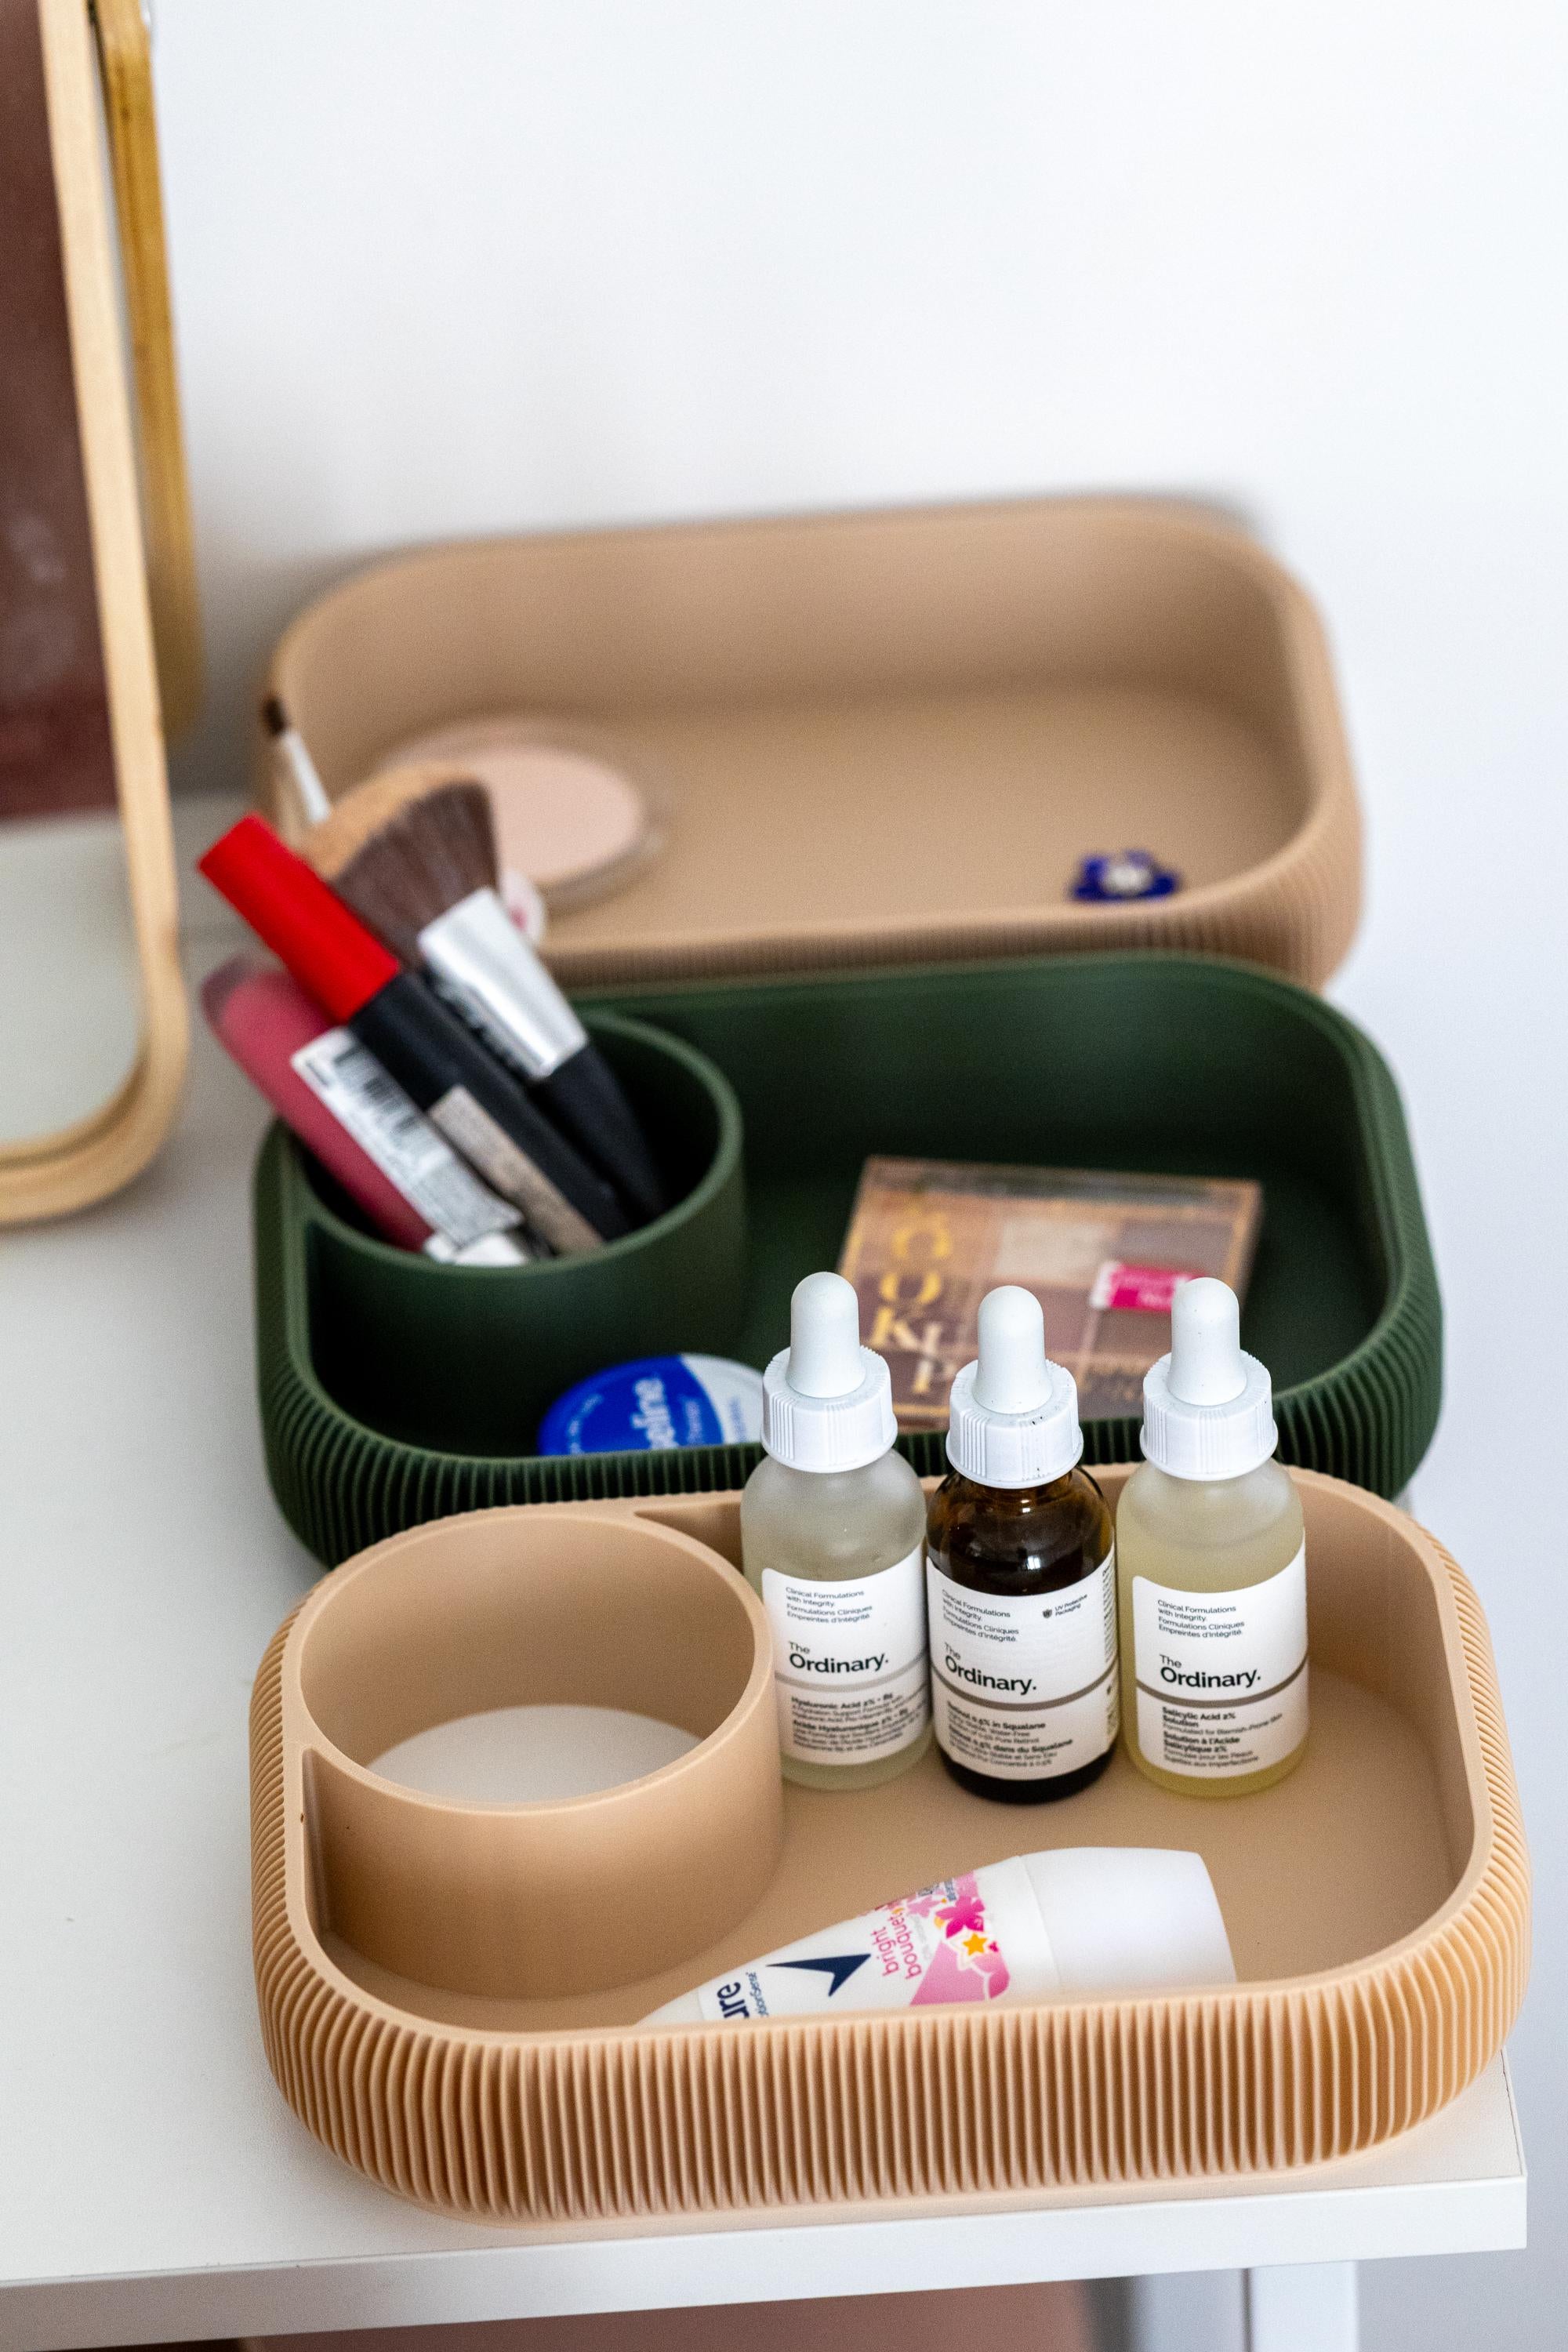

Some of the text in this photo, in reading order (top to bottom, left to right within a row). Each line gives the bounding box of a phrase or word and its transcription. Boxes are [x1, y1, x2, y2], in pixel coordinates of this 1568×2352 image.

[786, 1587, 811, 1598] Clinical
[786, 1603, 873, 1616] Formulations Cliniques
[963, 1602, 1011, 1617] Formulations
[1158, 1599, 1236, 1614] Clinical Formulations
[1158, 1608, 1174, 1617] with
[787, 1611, 829, 1623] Empreintes
[943, 1605, 1019, 1635] Formulations Cliniques
[1159, 1616, 1245, 1631] Formulations Cliniques
[1159, 1624, 1200, 1638] Empreintes
[789, 1641, 811, 1654] The
[945, 1642, 960, 1660] The
[789, 1653, 889, 1674] Ordinary.
[1160, 1653, 1182, 1668] The
[946, 1656, 1037, 1696] Ordinary.
[1160, 1666, 1261, 1688] Ordinary.
[1162, 1706, 1198, 1720] Salicylic
[1002, 1722, 1046, 1731] Squalane
[1163, 1715, 1199, 1727] Solution
[1163, 1730, 1200, 1744] Solution
[870, 1926, 899, 1977] bright
[887, 1911, 923, 1980] bouquet
[717, 1981, 750, 2019] ure
